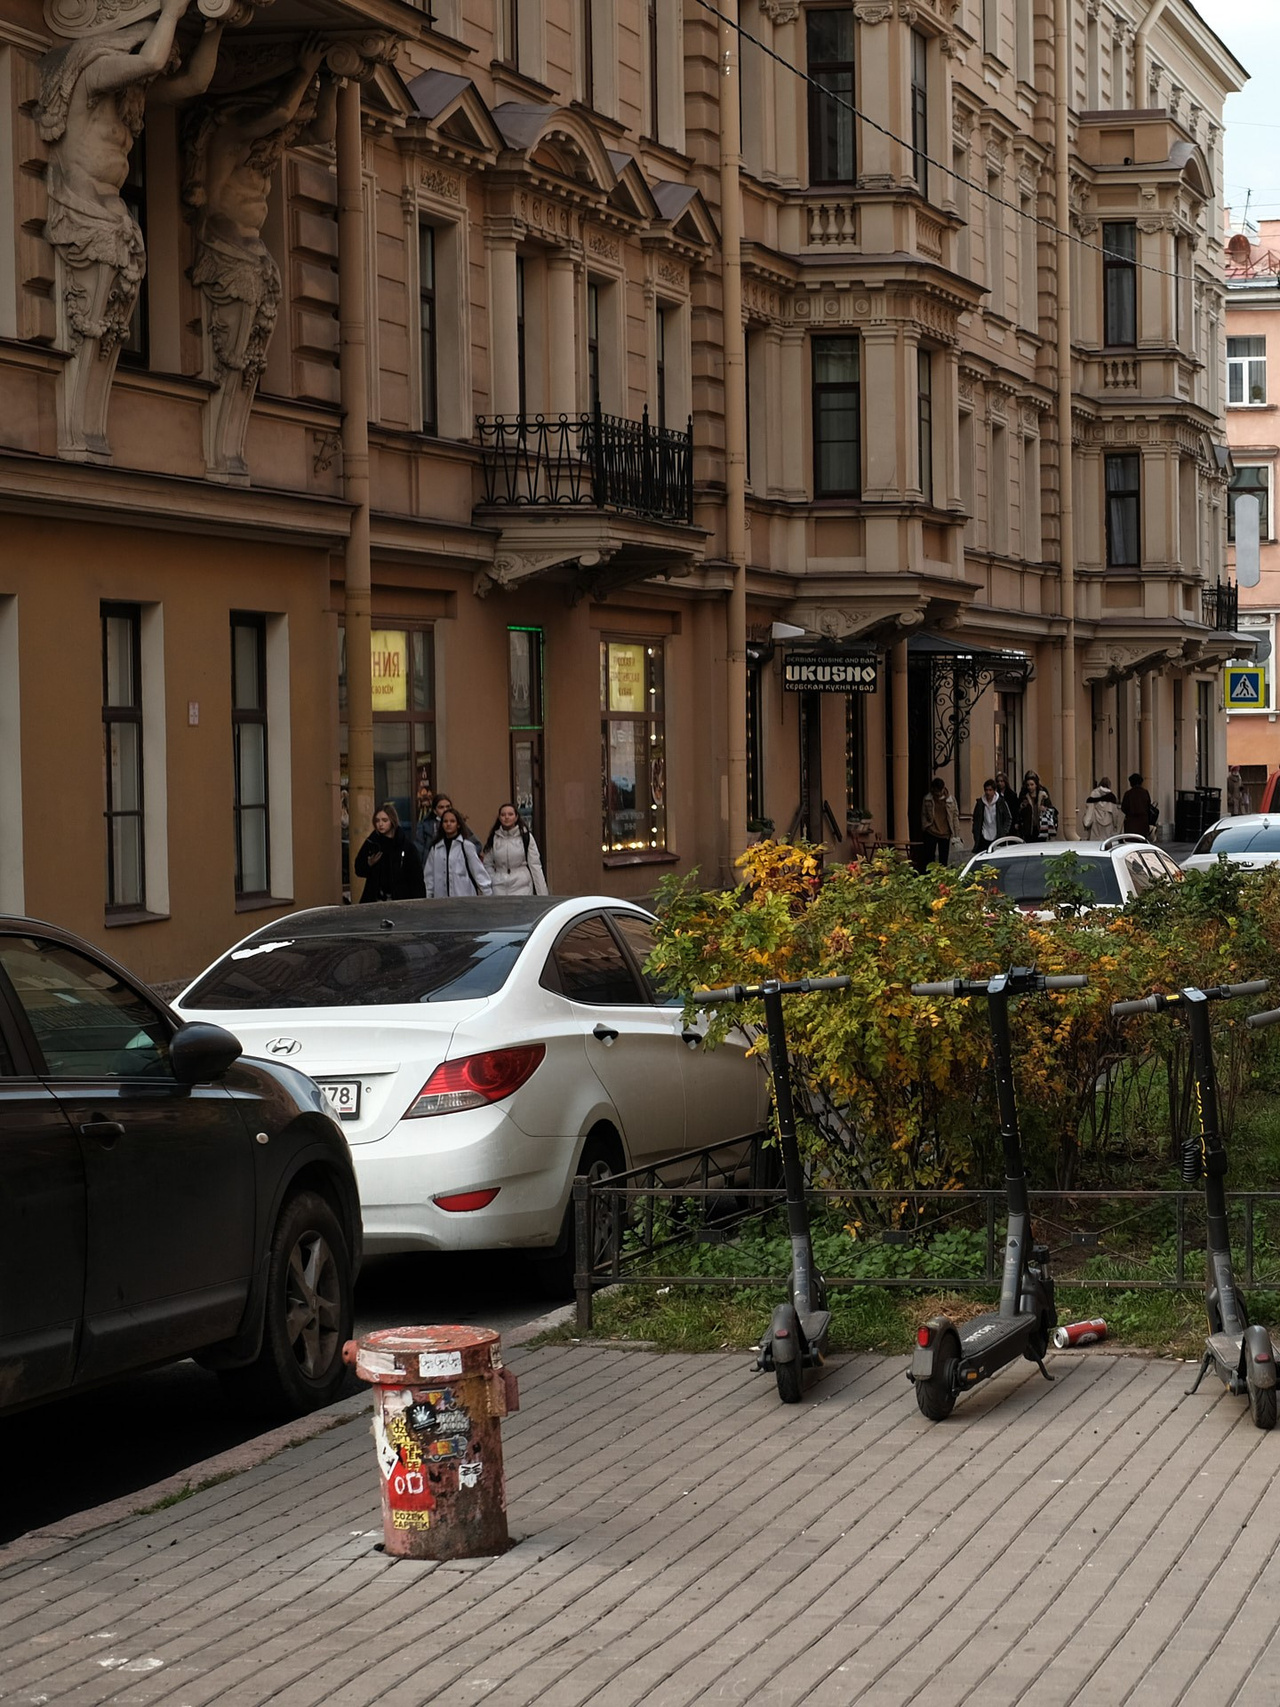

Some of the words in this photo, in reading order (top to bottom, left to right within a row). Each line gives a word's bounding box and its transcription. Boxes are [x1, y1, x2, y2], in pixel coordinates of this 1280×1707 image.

[373, 652, 400, 677] НИЯ
[786, 665, 876, 682] UKUSNO
[860, 684, 874, 692] БАР
[322, 1087, 350, 1105] 78
